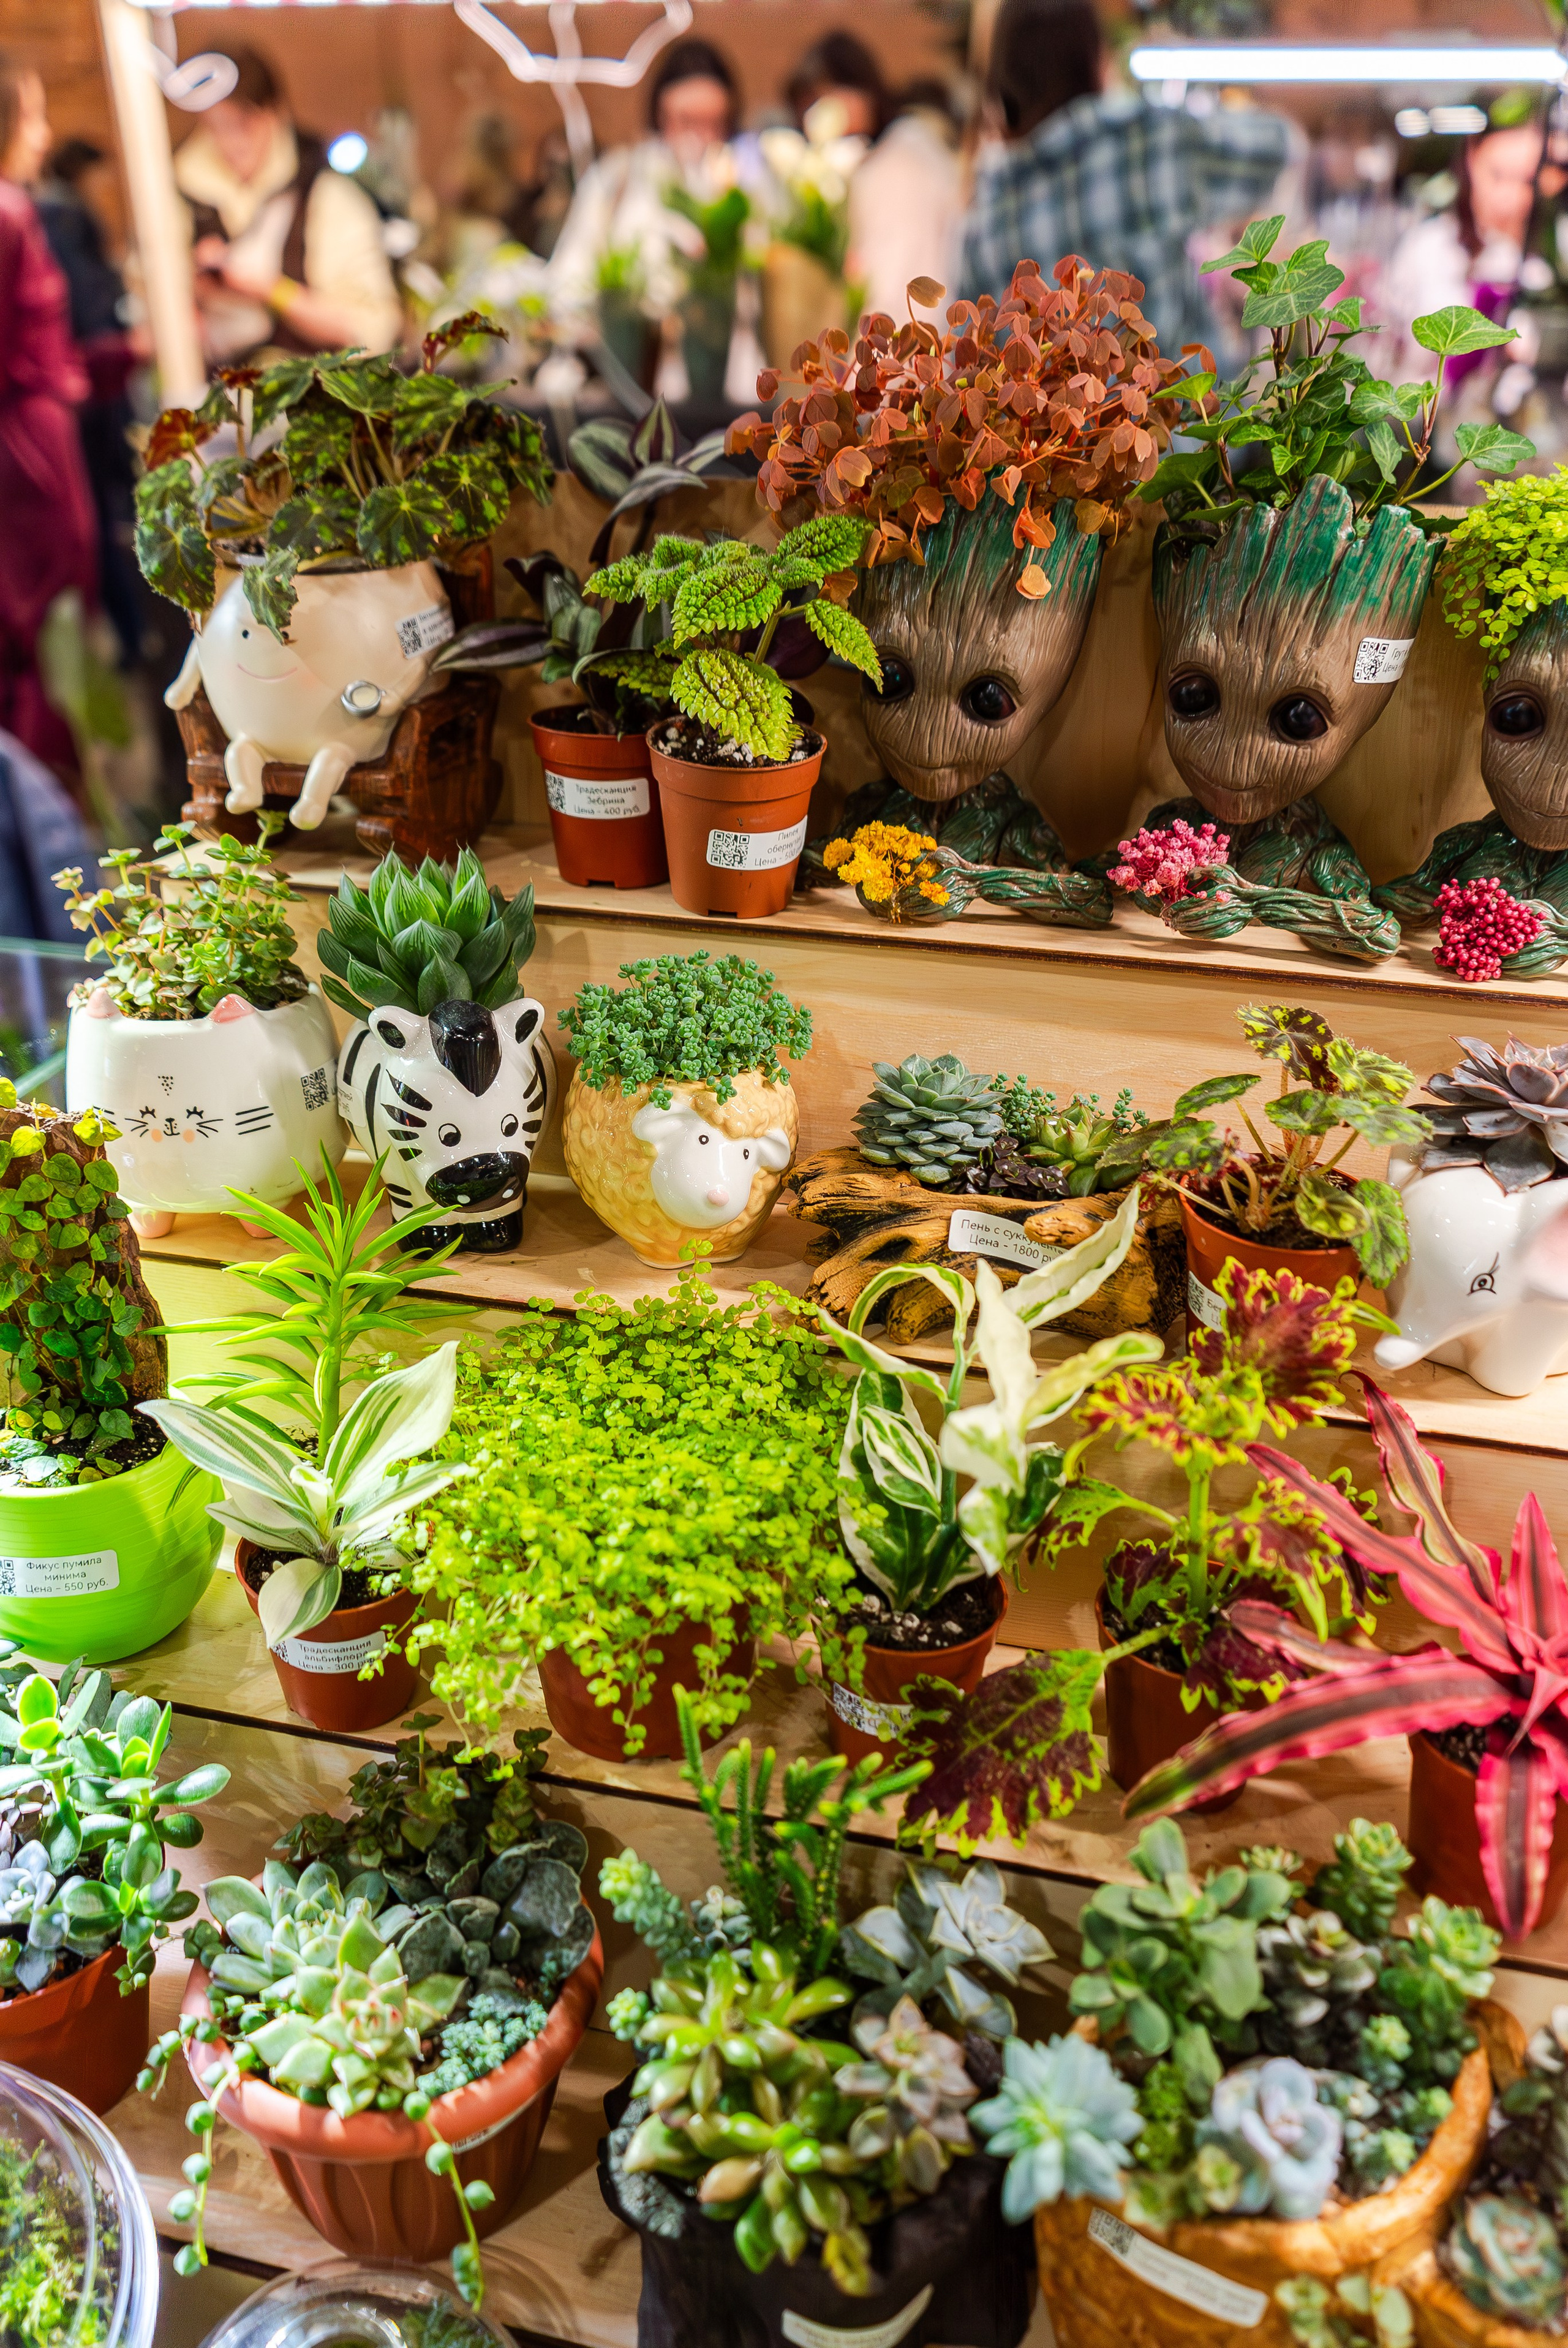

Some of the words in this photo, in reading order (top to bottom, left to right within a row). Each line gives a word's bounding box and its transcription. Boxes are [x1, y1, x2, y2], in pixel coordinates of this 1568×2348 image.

[576, 784, 636, 795] Традесканция
[575, 805, 595, 815] Цена
[755, 858, 777, 867] Цена
[961, 1219, 990, 1232] Пень
[970, 1234, 1000, 1248] Цена
[1012, 1244, 1039, 1259] 1800
[26, 1562, 59, 1572] Фикус
[62, 1557, 102, 1570] пумила
[44, 1571, 86, 1581] минима
[26, 1584, 53, 1593] Цена
[64, 1582, 83, 1591] 550
[87, 1577, 108, 1591] руб.
[298, 1641, 371, 1654] Традесканция
[298, 1660, 323, 1670] Цена
[334, 1662, 354, 1671] 300
